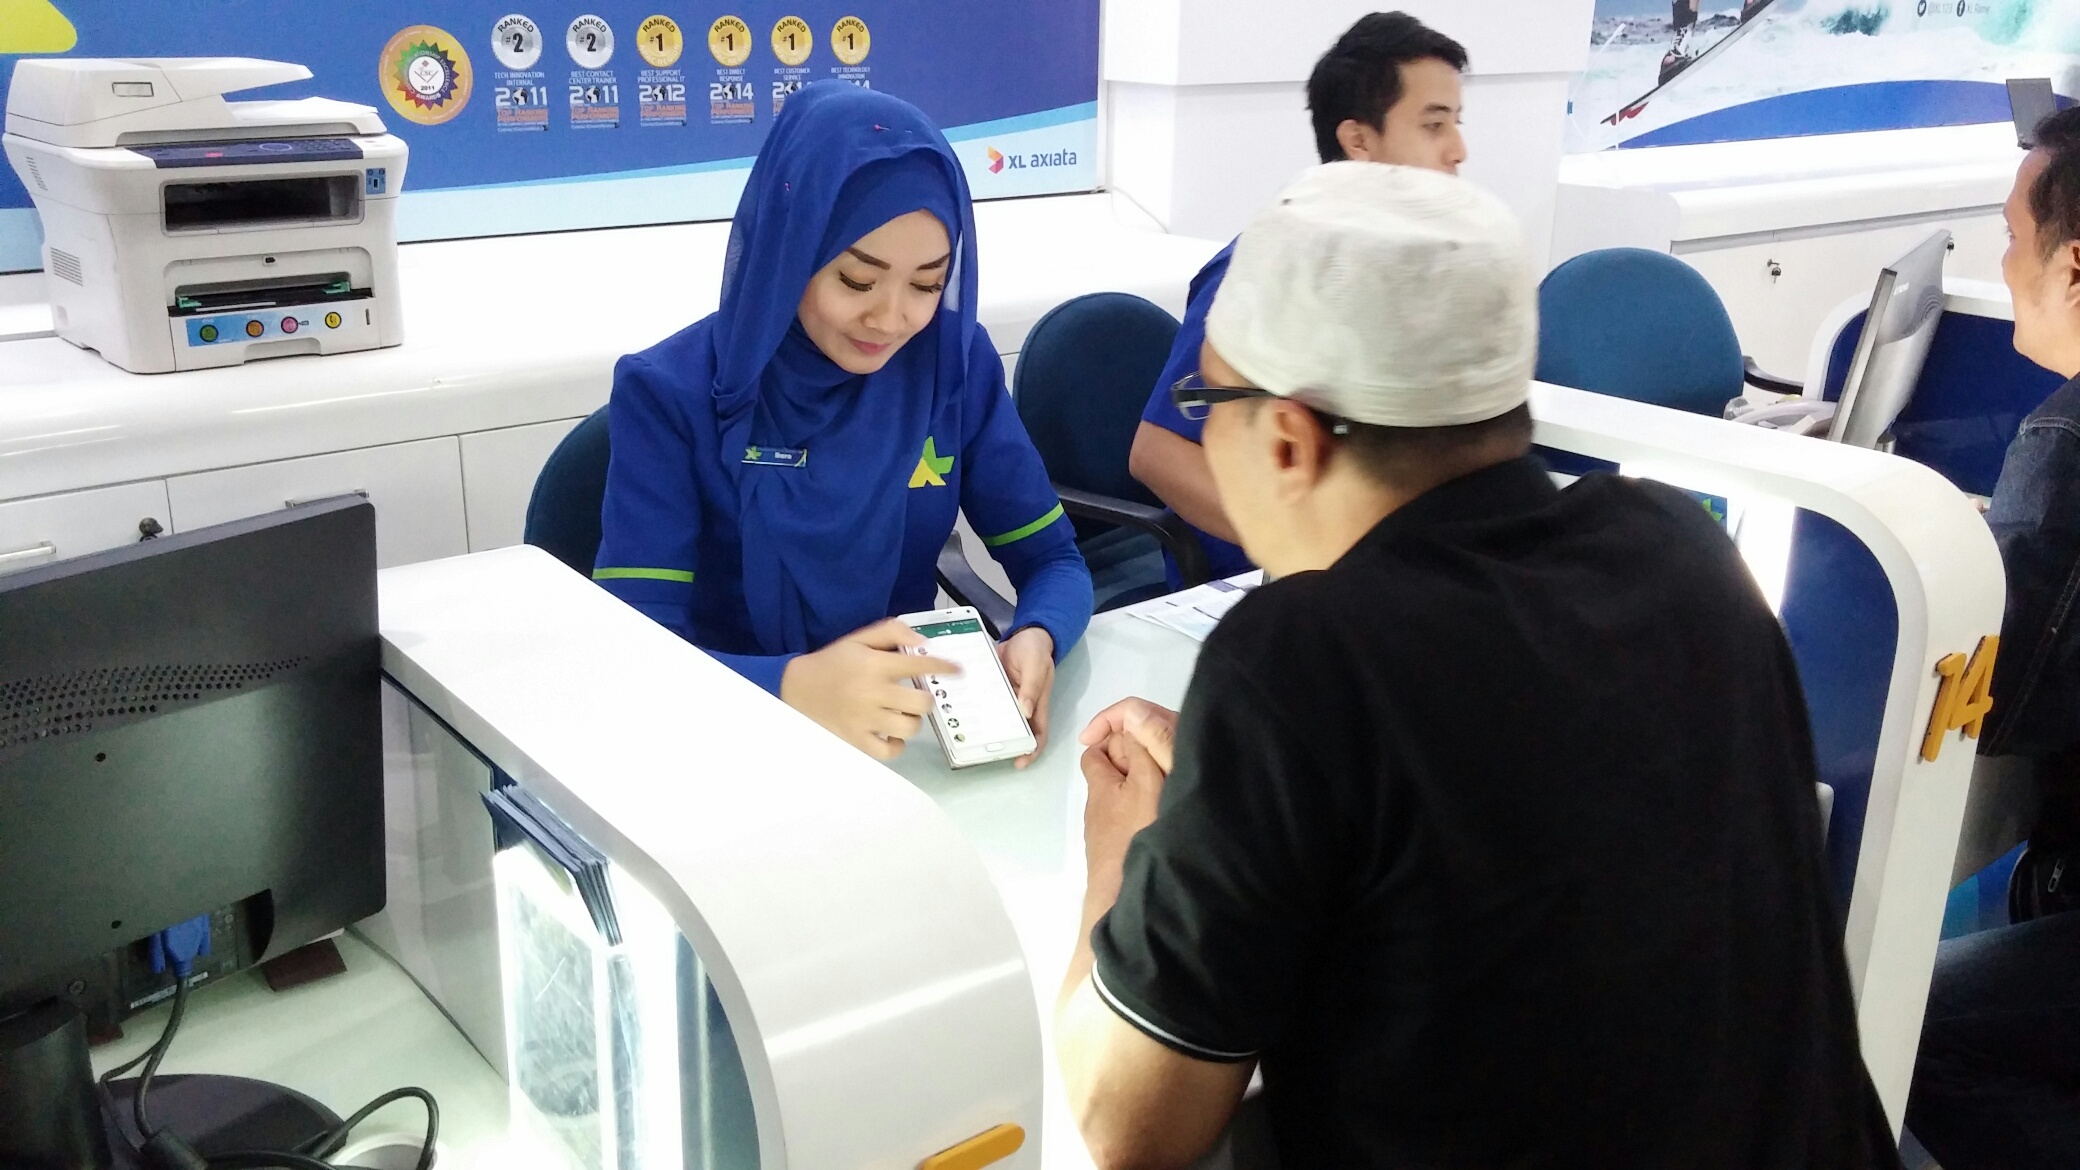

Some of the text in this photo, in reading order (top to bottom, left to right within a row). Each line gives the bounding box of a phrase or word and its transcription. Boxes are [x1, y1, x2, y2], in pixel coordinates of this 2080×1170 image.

[497, 17, 534, 33] RANKED
[572, 18, 607, 33] RANKED
[642, 18, 675, 33] RANKED
[714, 18, 745, 33] RANKED
[777, 18, 807, 33] RANKED
[836, 19, 865, 32] RANKED
[510, 71, 545, 79] INNOVATION
[1008, 148, 1077, 169] XL axiata
[1920, 635, 2000, 763] 14
